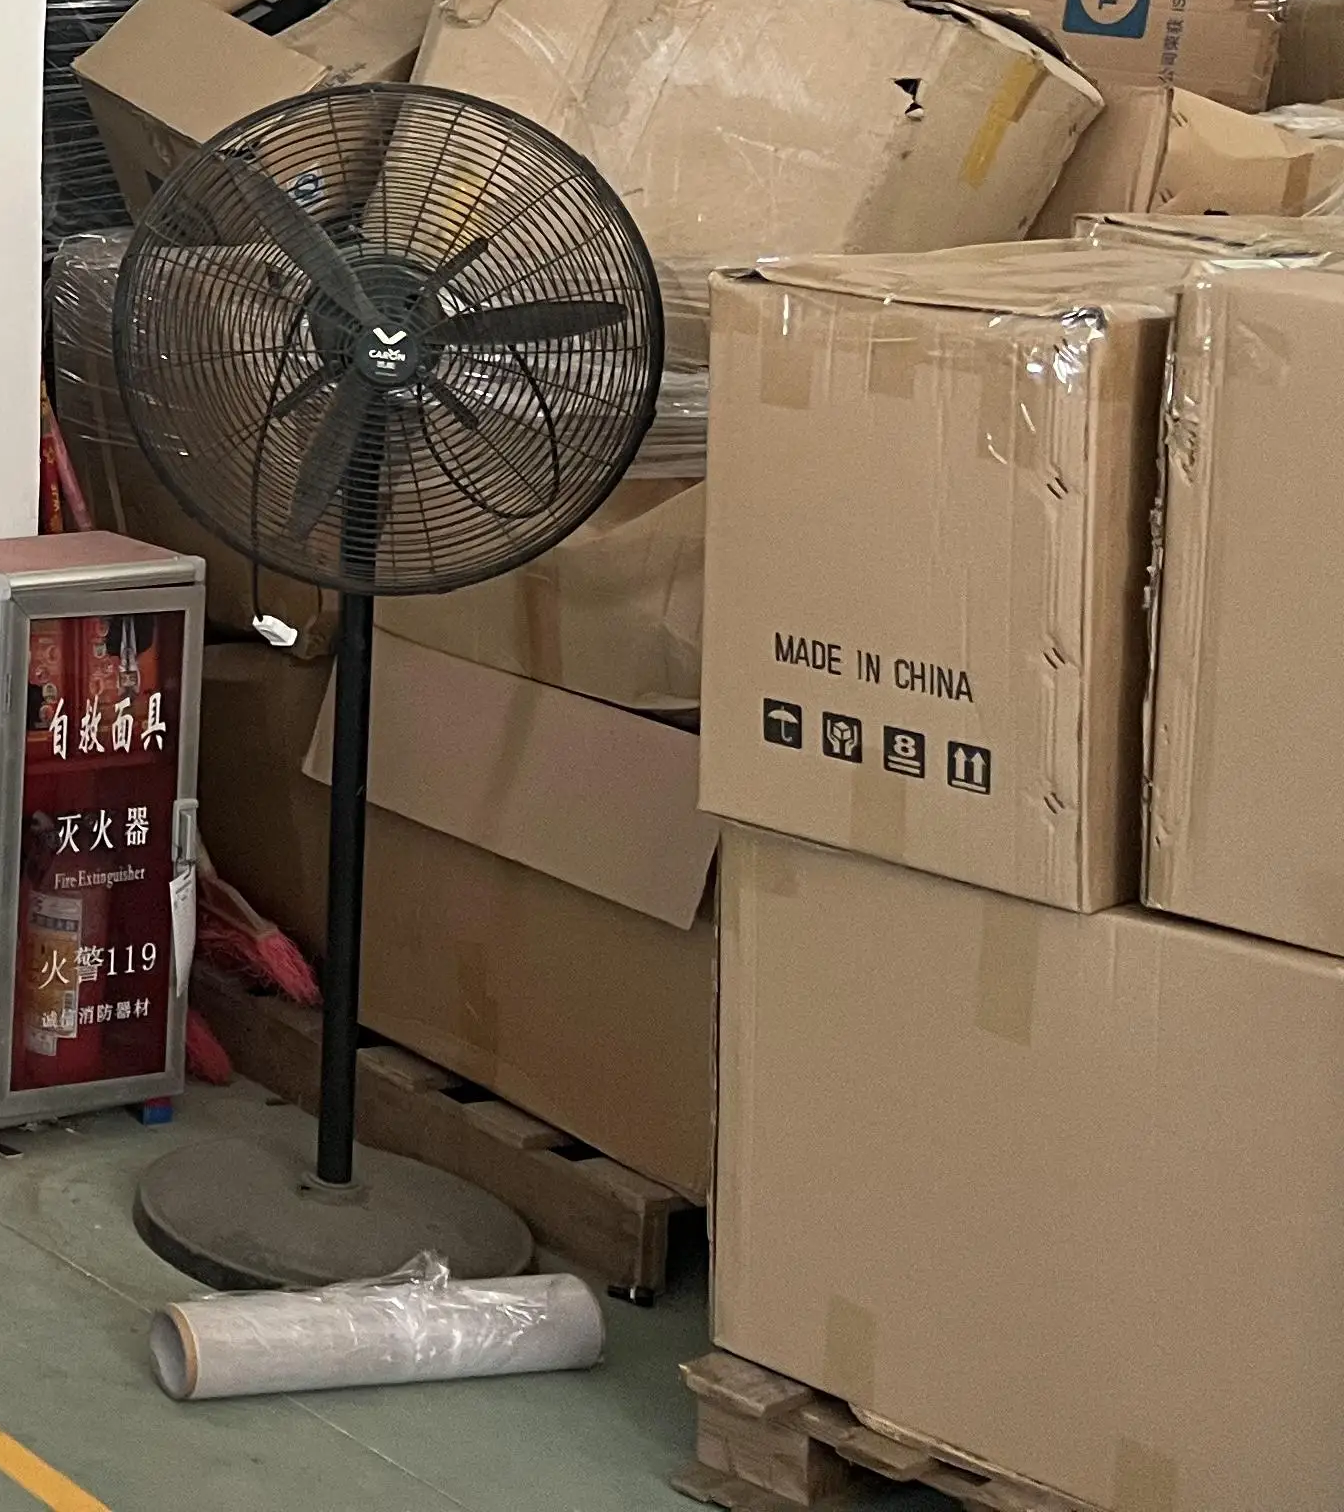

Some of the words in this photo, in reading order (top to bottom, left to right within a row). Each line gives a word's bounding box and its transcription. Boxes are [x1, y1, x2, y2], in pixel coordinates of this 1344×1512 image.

[774, 631, 842, 677] MADE
[856, 649, 881, 684] IN
[894, 658, 975, 705] CHINA
[48, 690, 167, 761] 自救面具
[56, 805, 150, 857] 灭火器
[53, 870, 76, 890] Fire
[77, 864, 147, 888] Extinguisher
[39, 939, 158, 991] 火警119
[40, 997, 151, 1030] 诚信消防器材
